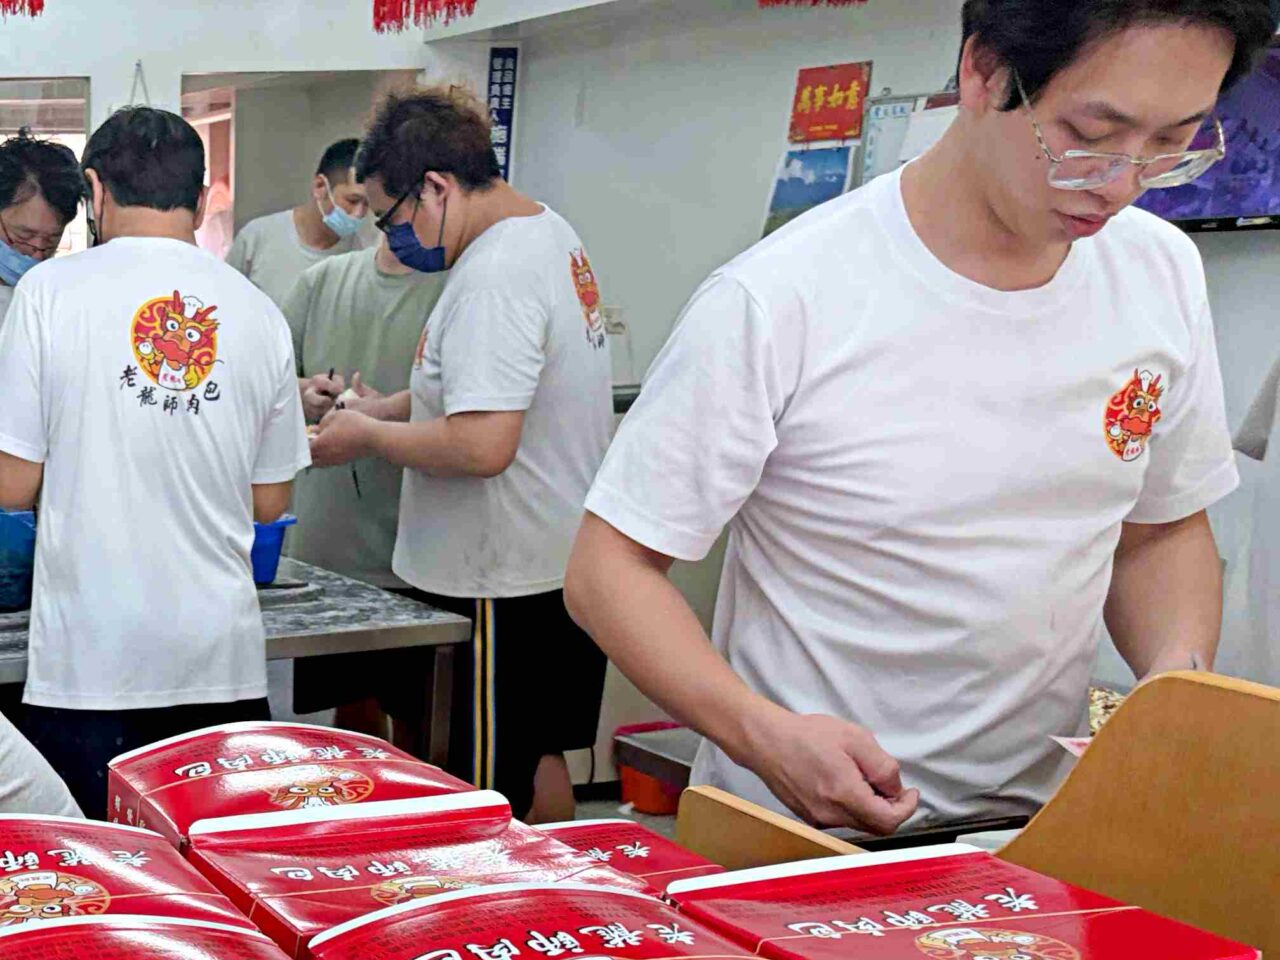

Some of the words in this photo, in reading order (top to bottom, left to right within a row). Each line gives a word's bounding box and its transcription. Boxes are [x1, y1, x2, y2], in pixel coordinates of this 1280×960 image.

[120, 364, 221, 416] 老龍師肉包
[787, 885, 1040, 940] 老龍師肉包
